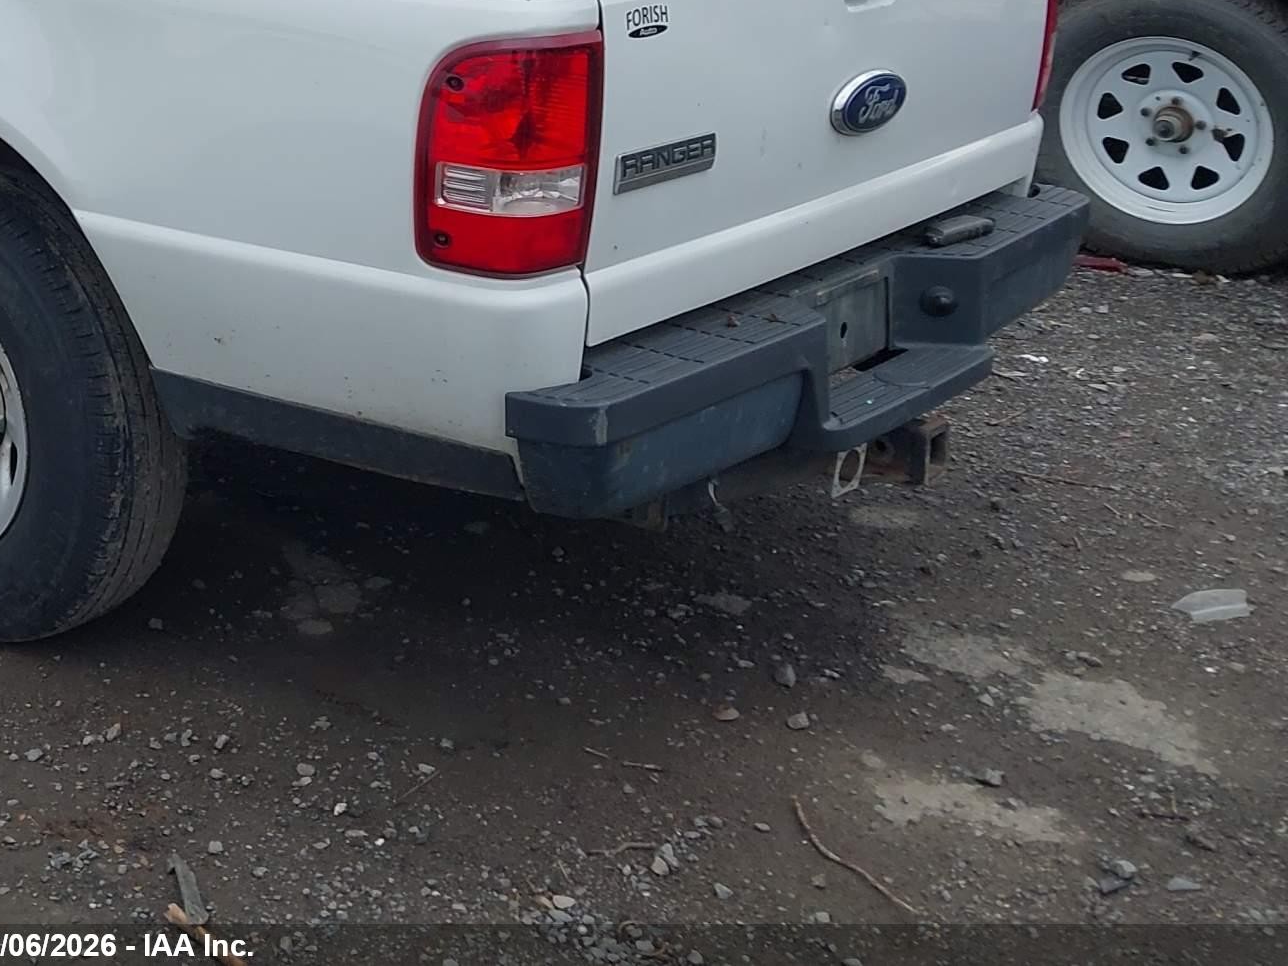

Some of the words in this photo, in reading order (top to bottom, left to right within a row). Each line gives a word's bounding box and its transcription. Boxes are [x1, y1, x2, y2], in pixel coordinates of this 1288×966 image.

[626, 4, 669, 30] FORISH
[858, 83, 899, 124] Ford
[622, 137, 715, 177] RANGER
